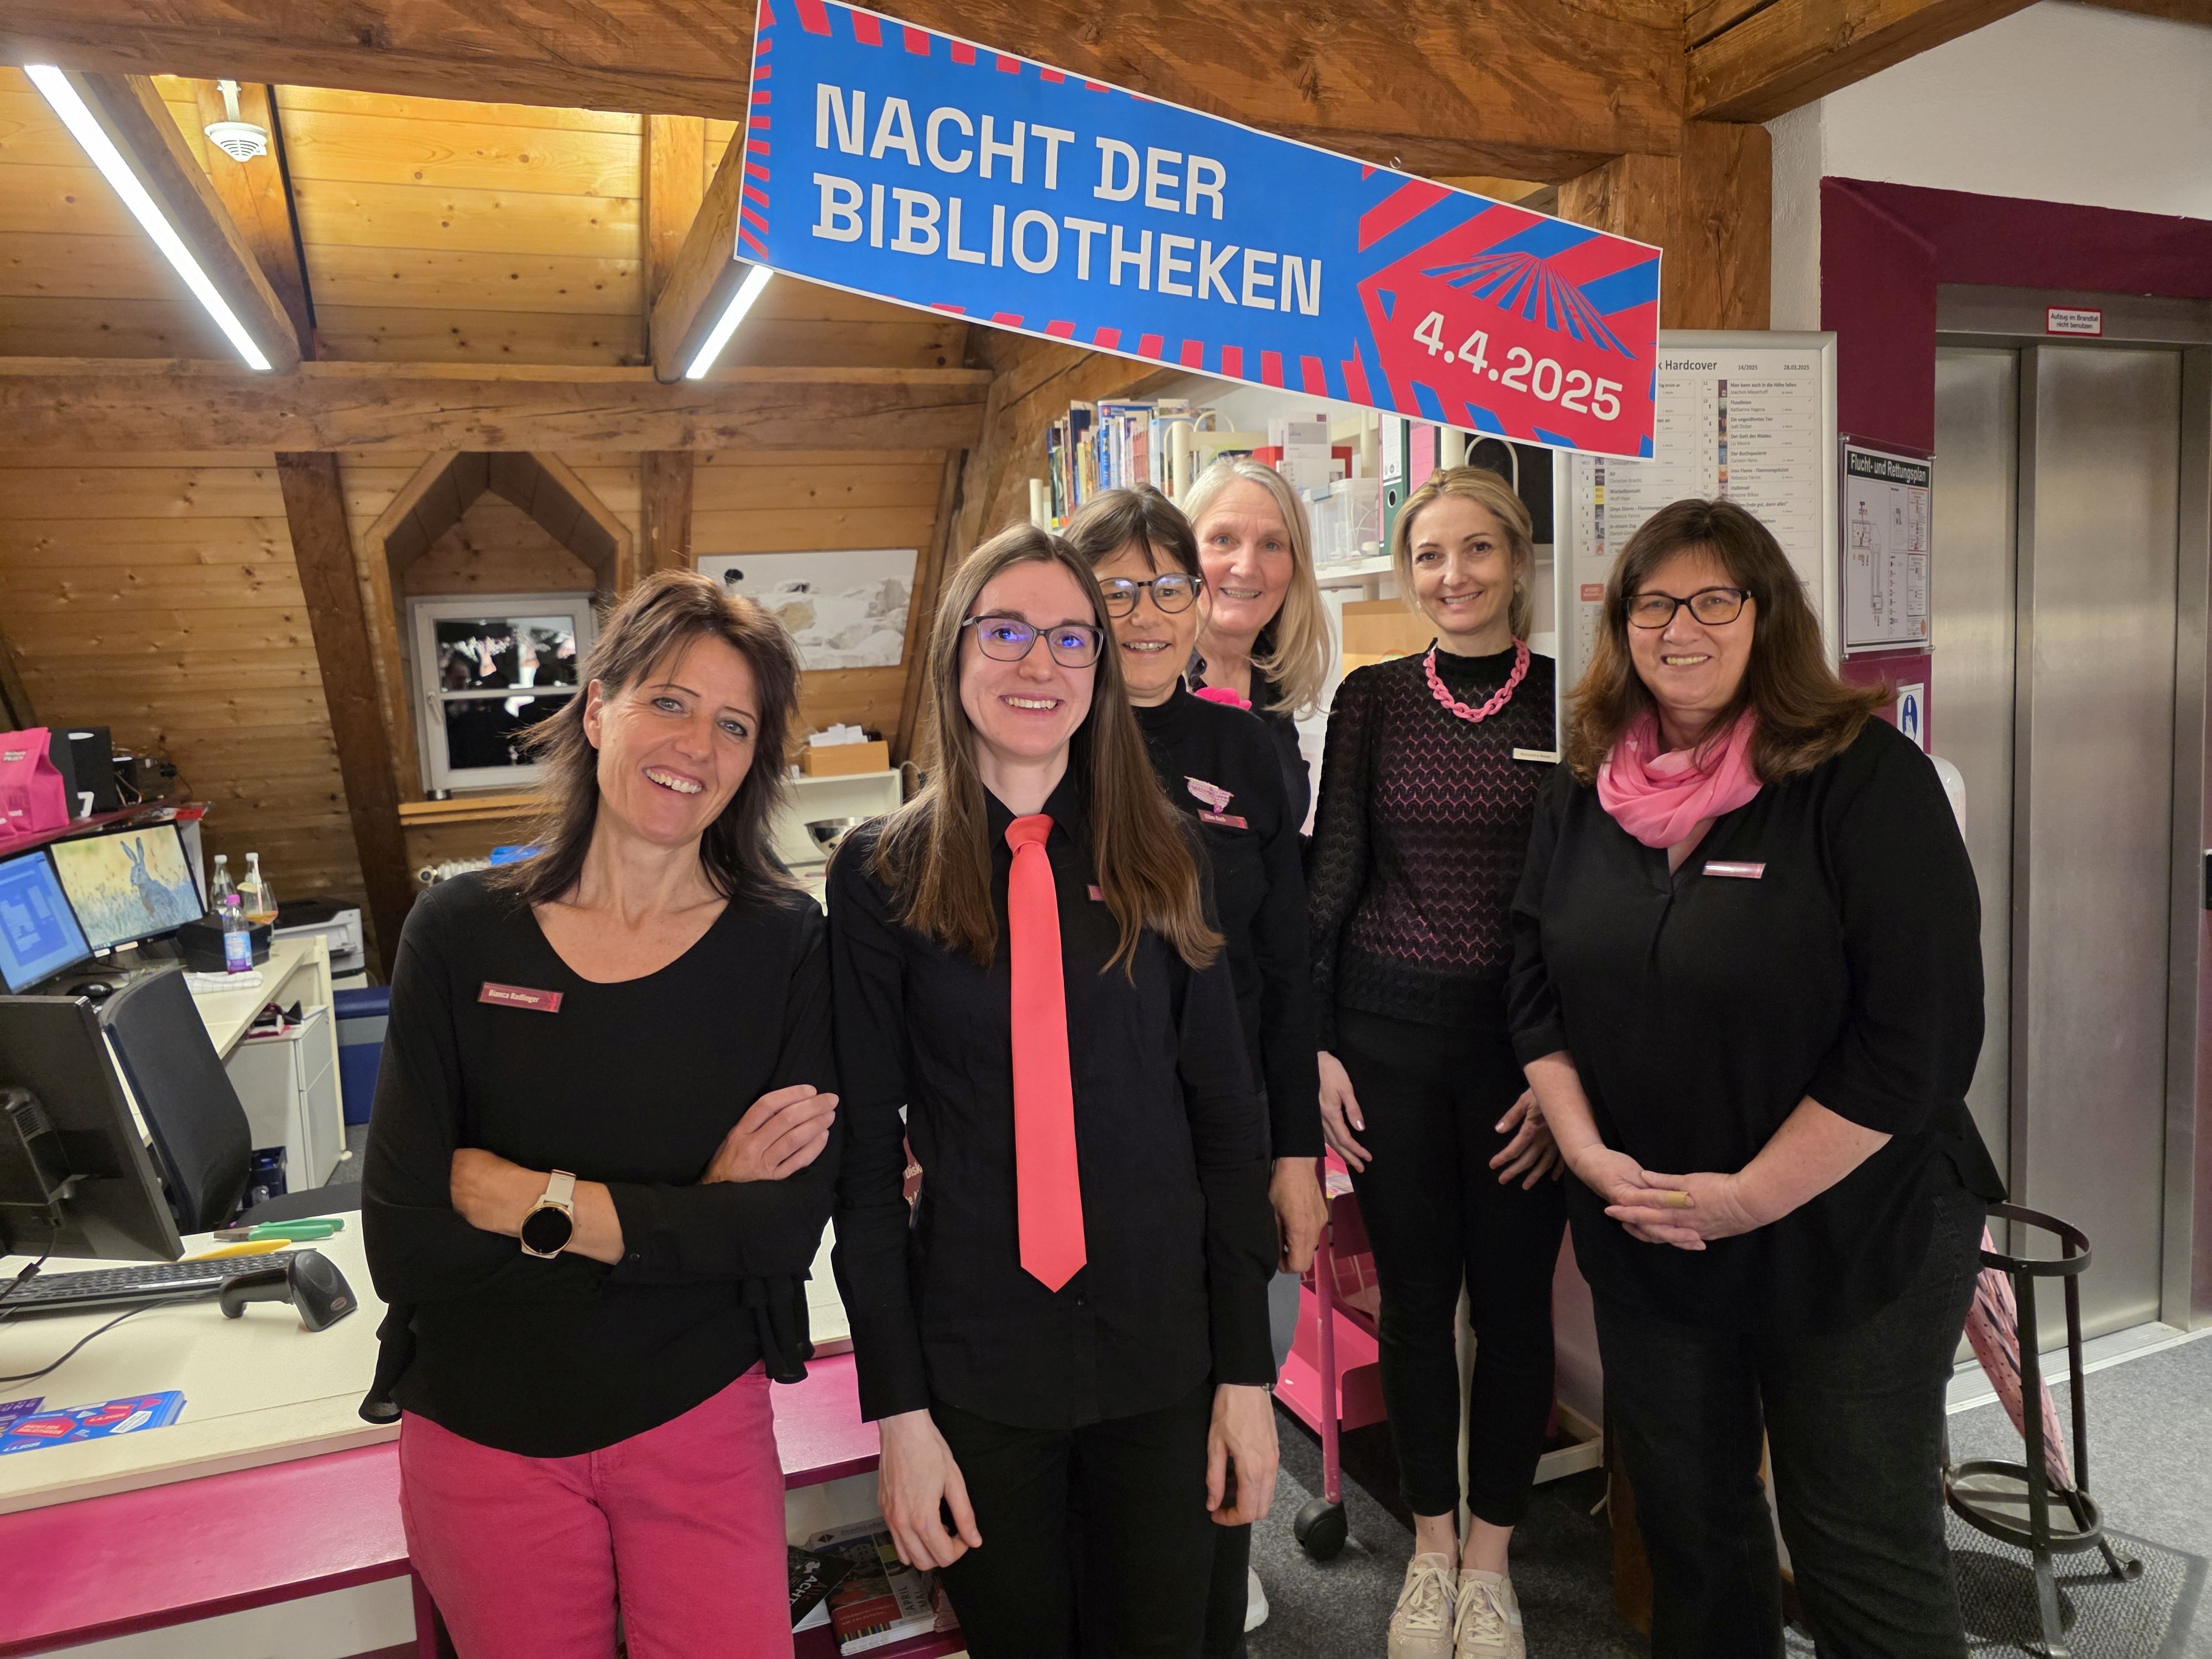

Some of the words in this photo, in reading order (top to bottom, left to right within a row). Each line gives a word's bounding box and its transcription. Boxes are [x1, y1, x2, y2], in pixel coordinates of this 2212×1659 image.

[816, 82, 1075, 190] NACHT
[1093, 136, 1226, 220] DER
[812, 172, 1321, 317] BIBLIOTHEKEN
[1413, 311, 1623, 421] 4.4.2025
[1665, 359, 1717, 370] Hardcover
[1851, 453, 1873, 473] Flucht-
[1874, 460, 1886, 475] und
[1887, 461, 1926, 484] Rettungsplan
[488, 989, 509, 999] Bianca
[898, 1586, 916, 1610] APRIL
[914, 1590, 929, 1608] MAI
